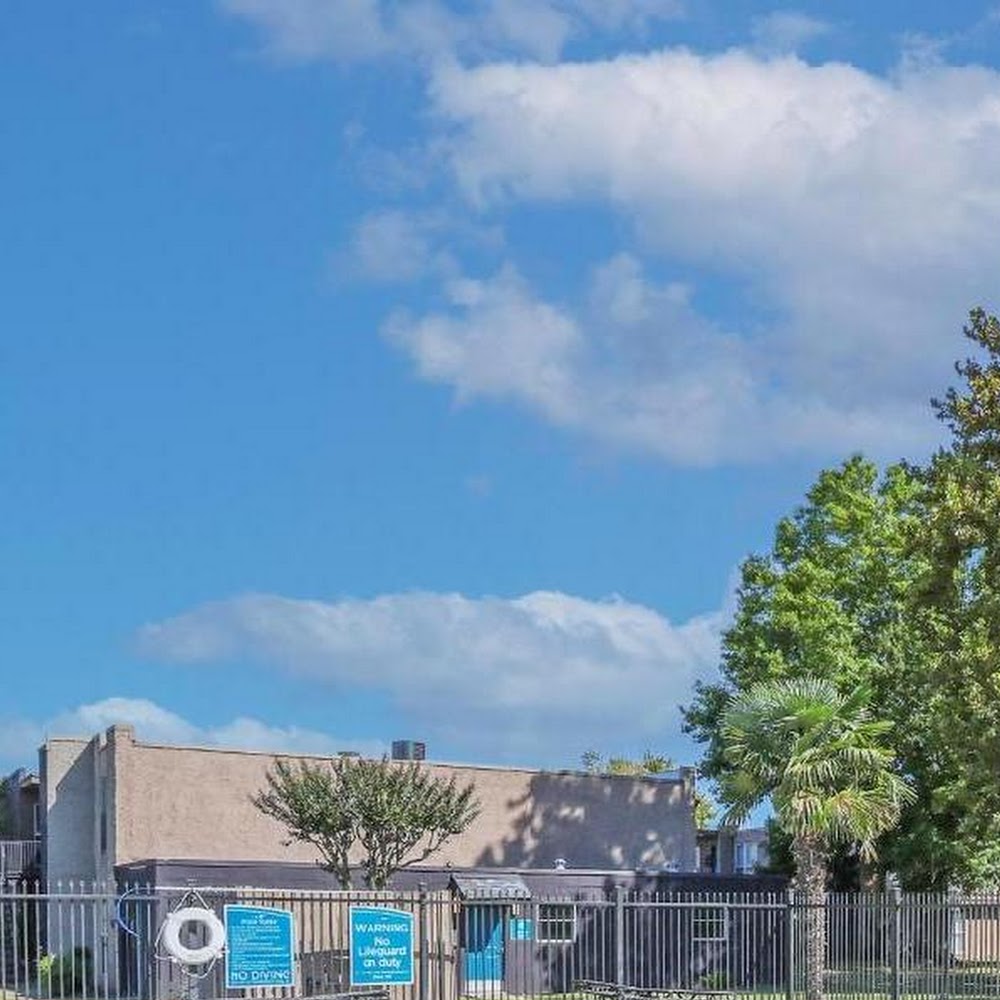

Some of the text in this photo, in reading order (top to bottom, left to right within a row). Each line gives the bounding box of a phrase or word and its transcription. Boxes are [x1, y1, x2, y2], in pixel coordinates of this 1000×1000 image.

[355, 923, 409, 933] WARNING
[374, 936, 390, 946] No
[358, 946, 407, 957] Lifeguard
[363, 957, 402, 969] on duty
[230, 969, 290, 981] NO DIVING
